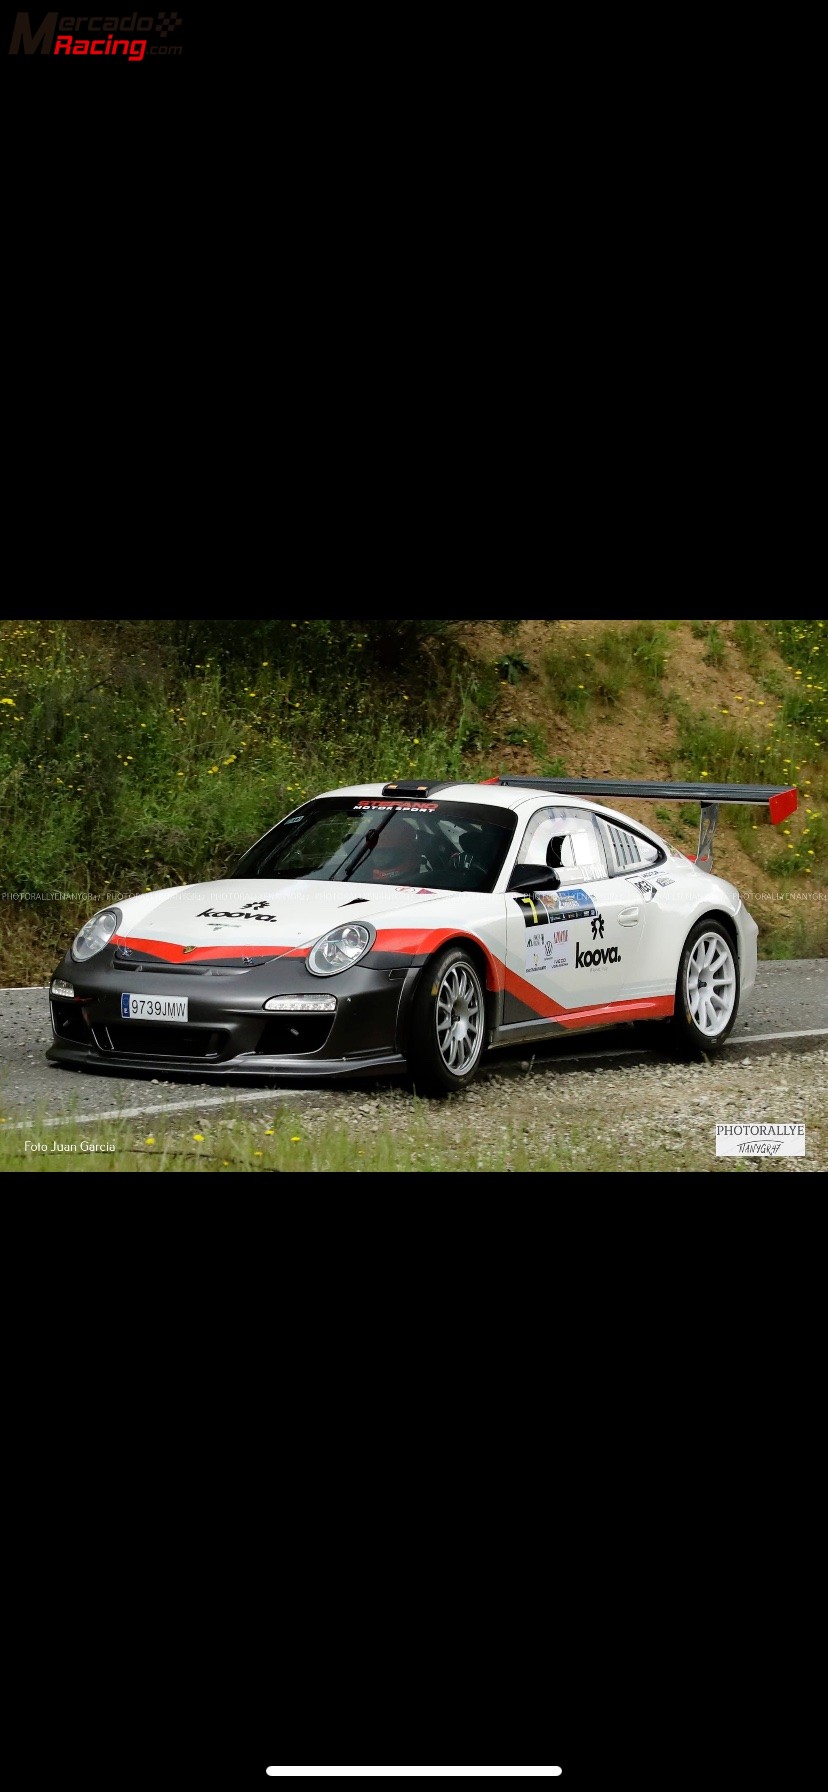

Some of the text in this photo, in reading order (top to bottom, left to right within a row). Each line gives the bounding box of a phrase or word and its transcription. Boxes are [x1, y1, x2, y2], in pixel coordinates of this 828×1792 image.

[357, 800, 439, 809] STEFANO
[521, 897, 538, 924] 7
[575, 941, 622, 969] koova.
[131, 999, 186, 1017] 9739JMW
